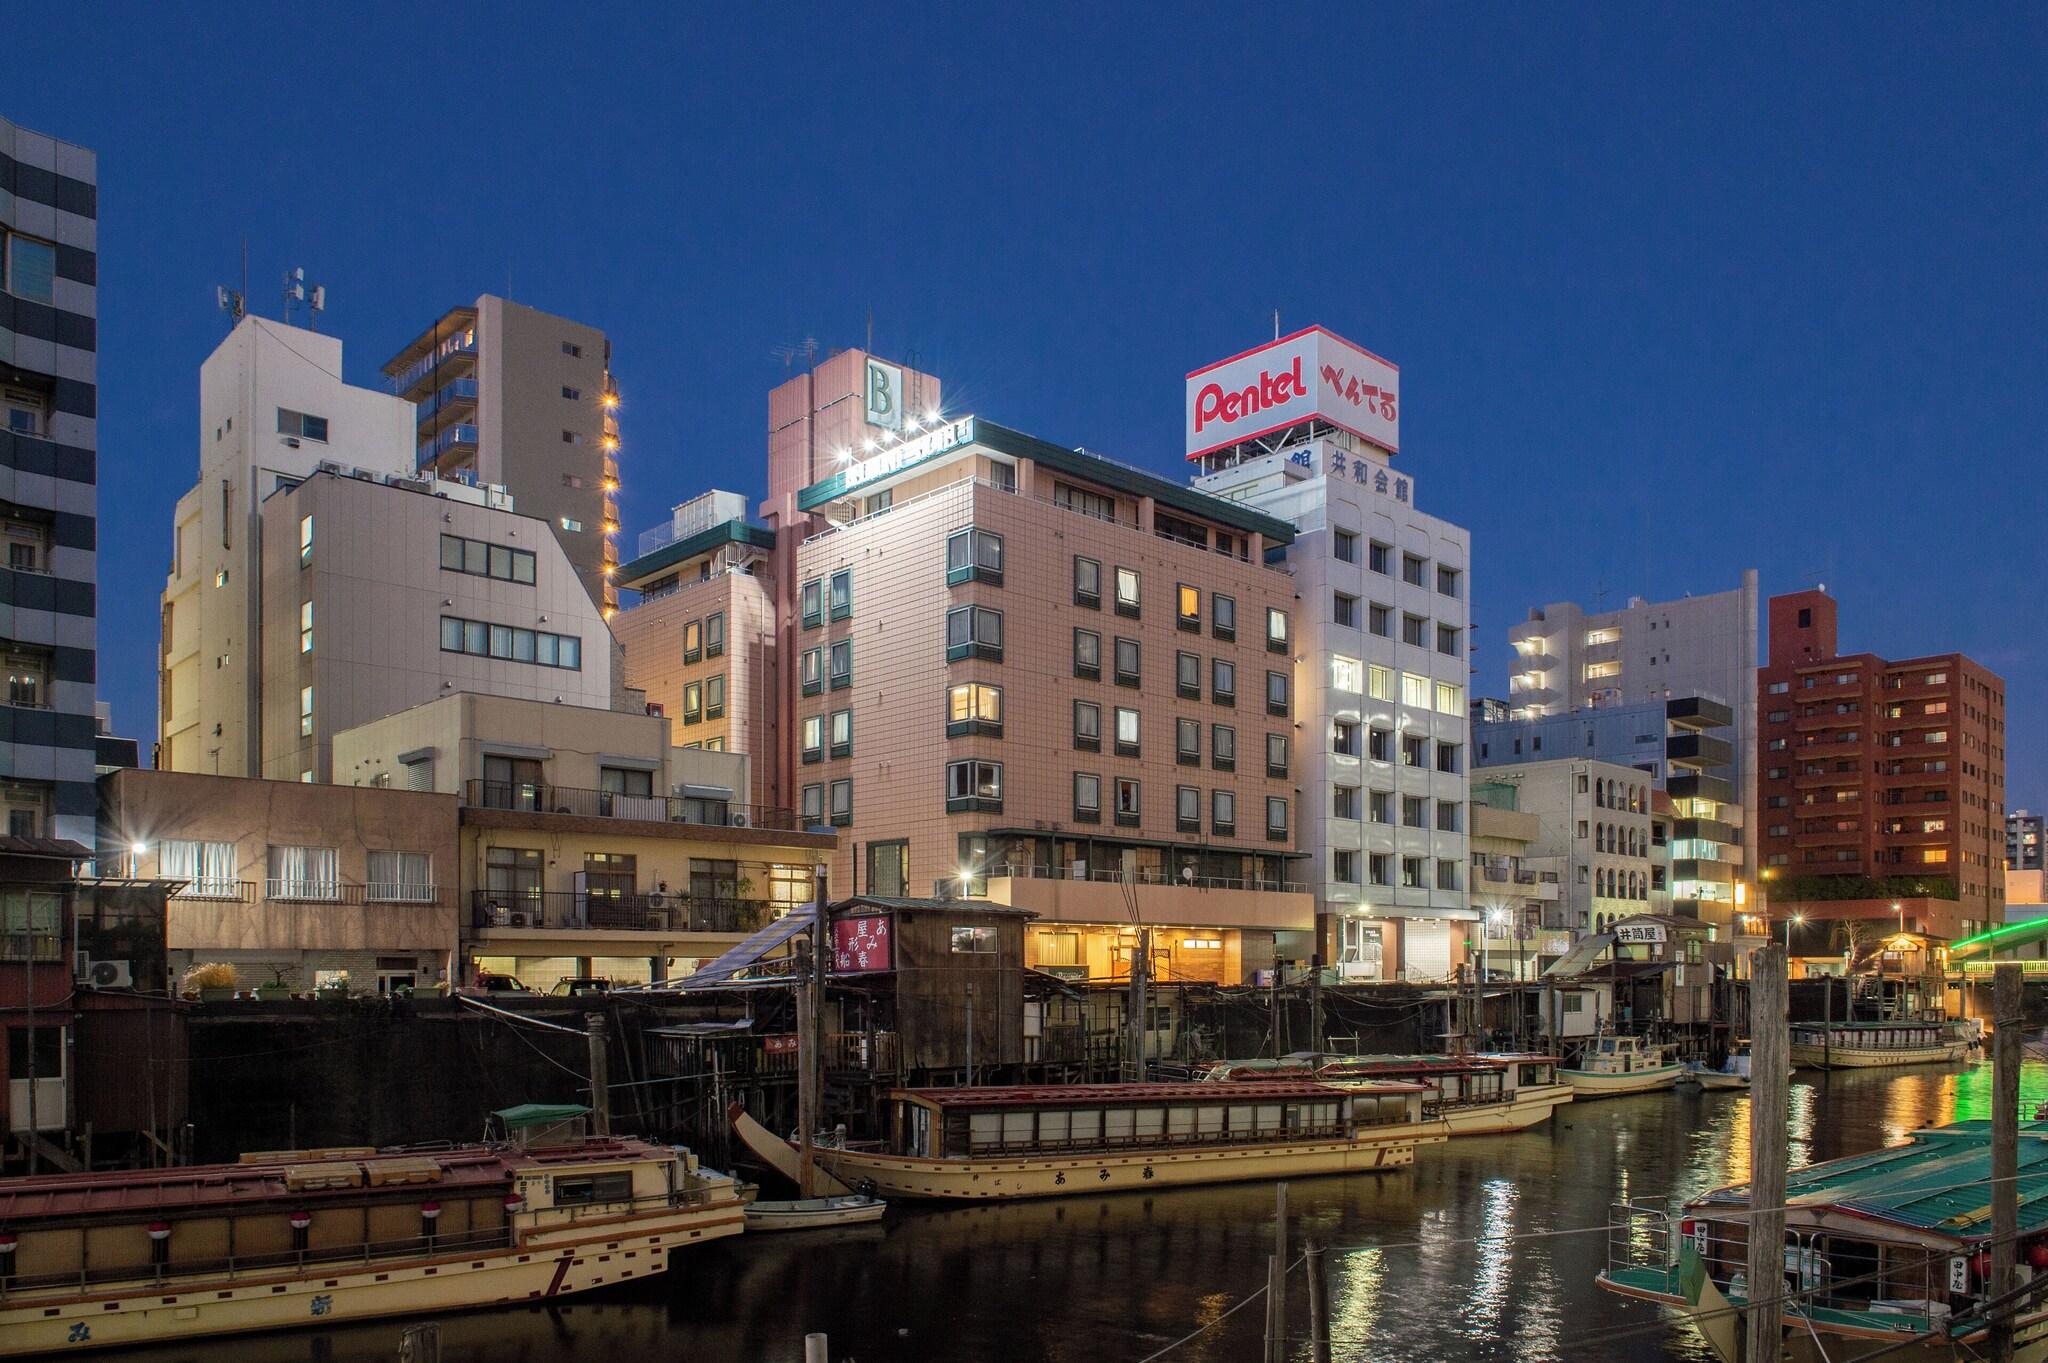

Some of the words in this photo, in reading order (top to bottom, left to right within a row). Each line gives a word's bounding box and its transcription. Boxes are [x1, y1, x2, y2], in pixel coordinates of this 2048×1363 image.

[869, 365, 893, 415] B
[1194, 355, 1307, 433] Pentel
[1331, 449, 1409, 503] 共和会館
[840, 920, 868, 969] 屋形船
[1619, 927, 1657, 941] 井筒屋
